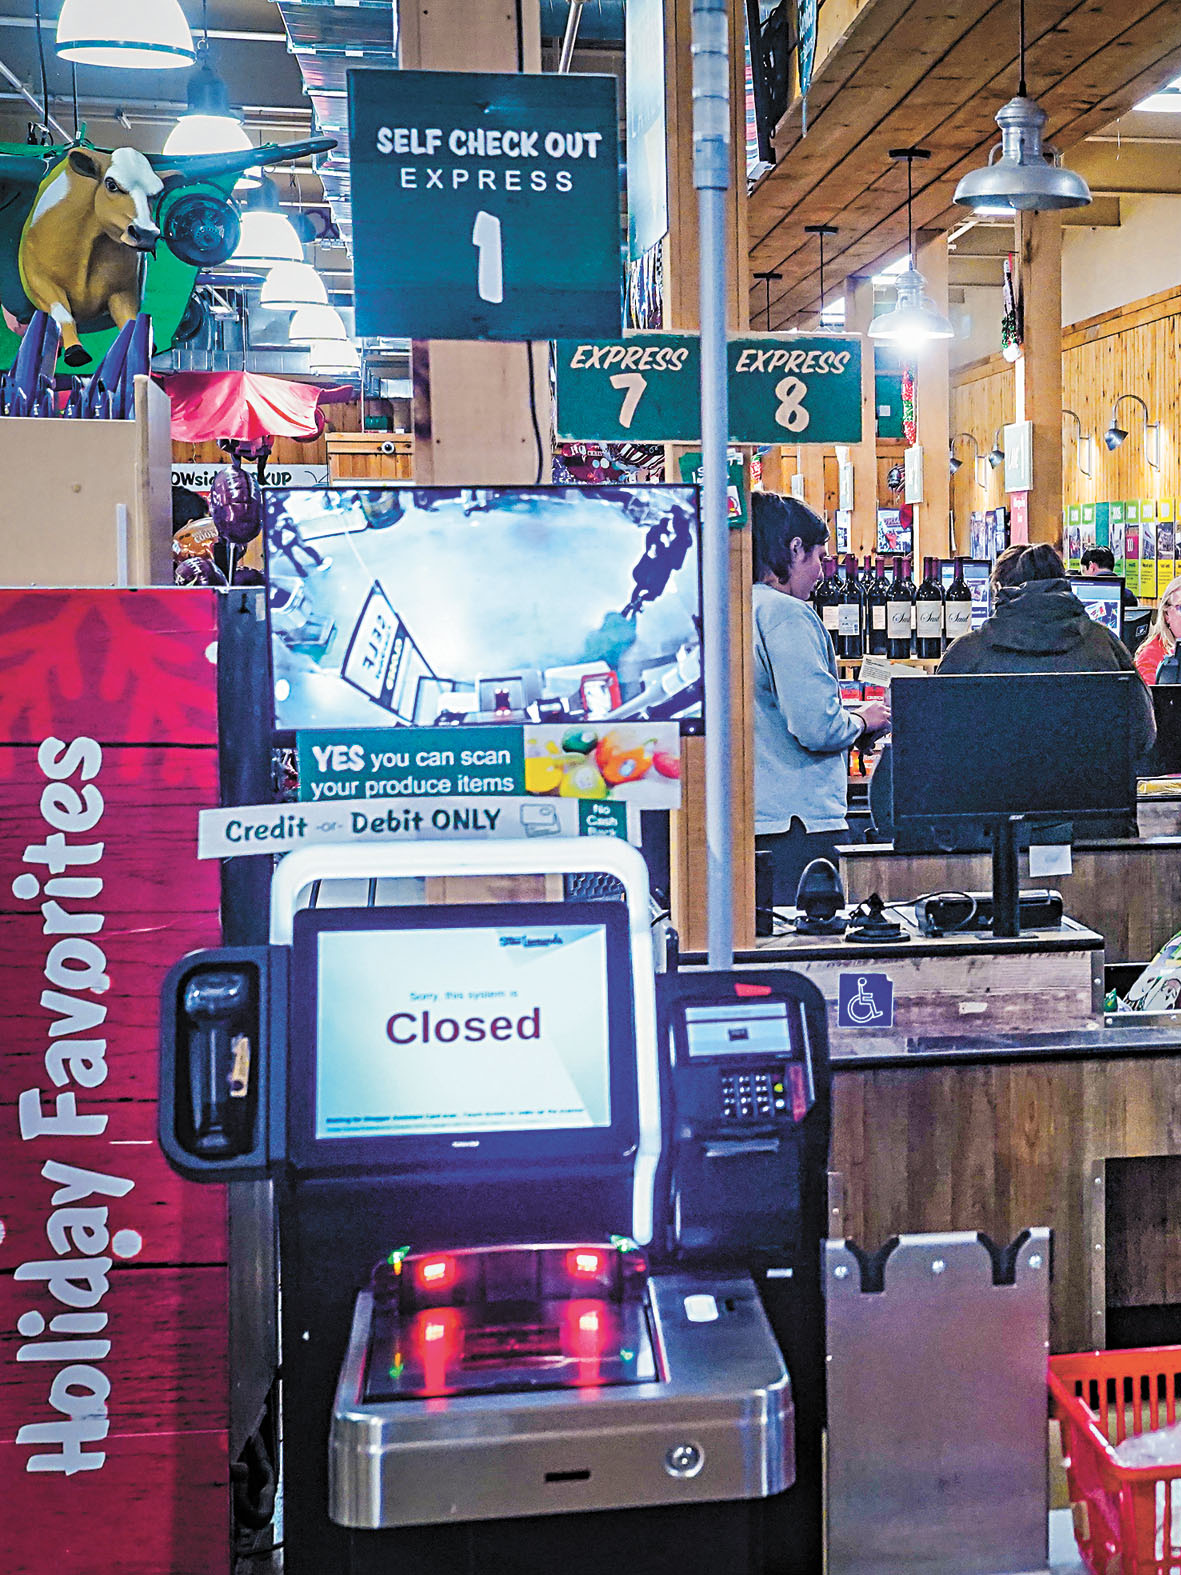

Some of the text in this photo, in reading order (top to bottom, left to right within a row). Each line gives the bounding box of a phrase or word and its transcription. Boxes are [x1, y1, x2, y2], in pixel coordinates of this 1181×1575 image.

[376, 127, 602, 158] SELF CHECK OUT
[400, 167, 573, 192] EXPRESS
[472, 210, 503, 303] 1
[570, 345, 688, 371] EXPRESS
[736, 349, 851, 374] EXPRESS
[609, 372, 648, 429] 7
[774, 376, 810, 433] 8
[312, 745, 511, 773] YES you can scan
[310, 774, 514, 800] your produce items
[225, 815, 307, 842] Credit
[351, 808, 423, 834] Debit
[431, 807, 501, 832] ONLY
[386, 1006, 541, 1044] Closed
[12, 736, 135, 1476] Holiday Favorites
